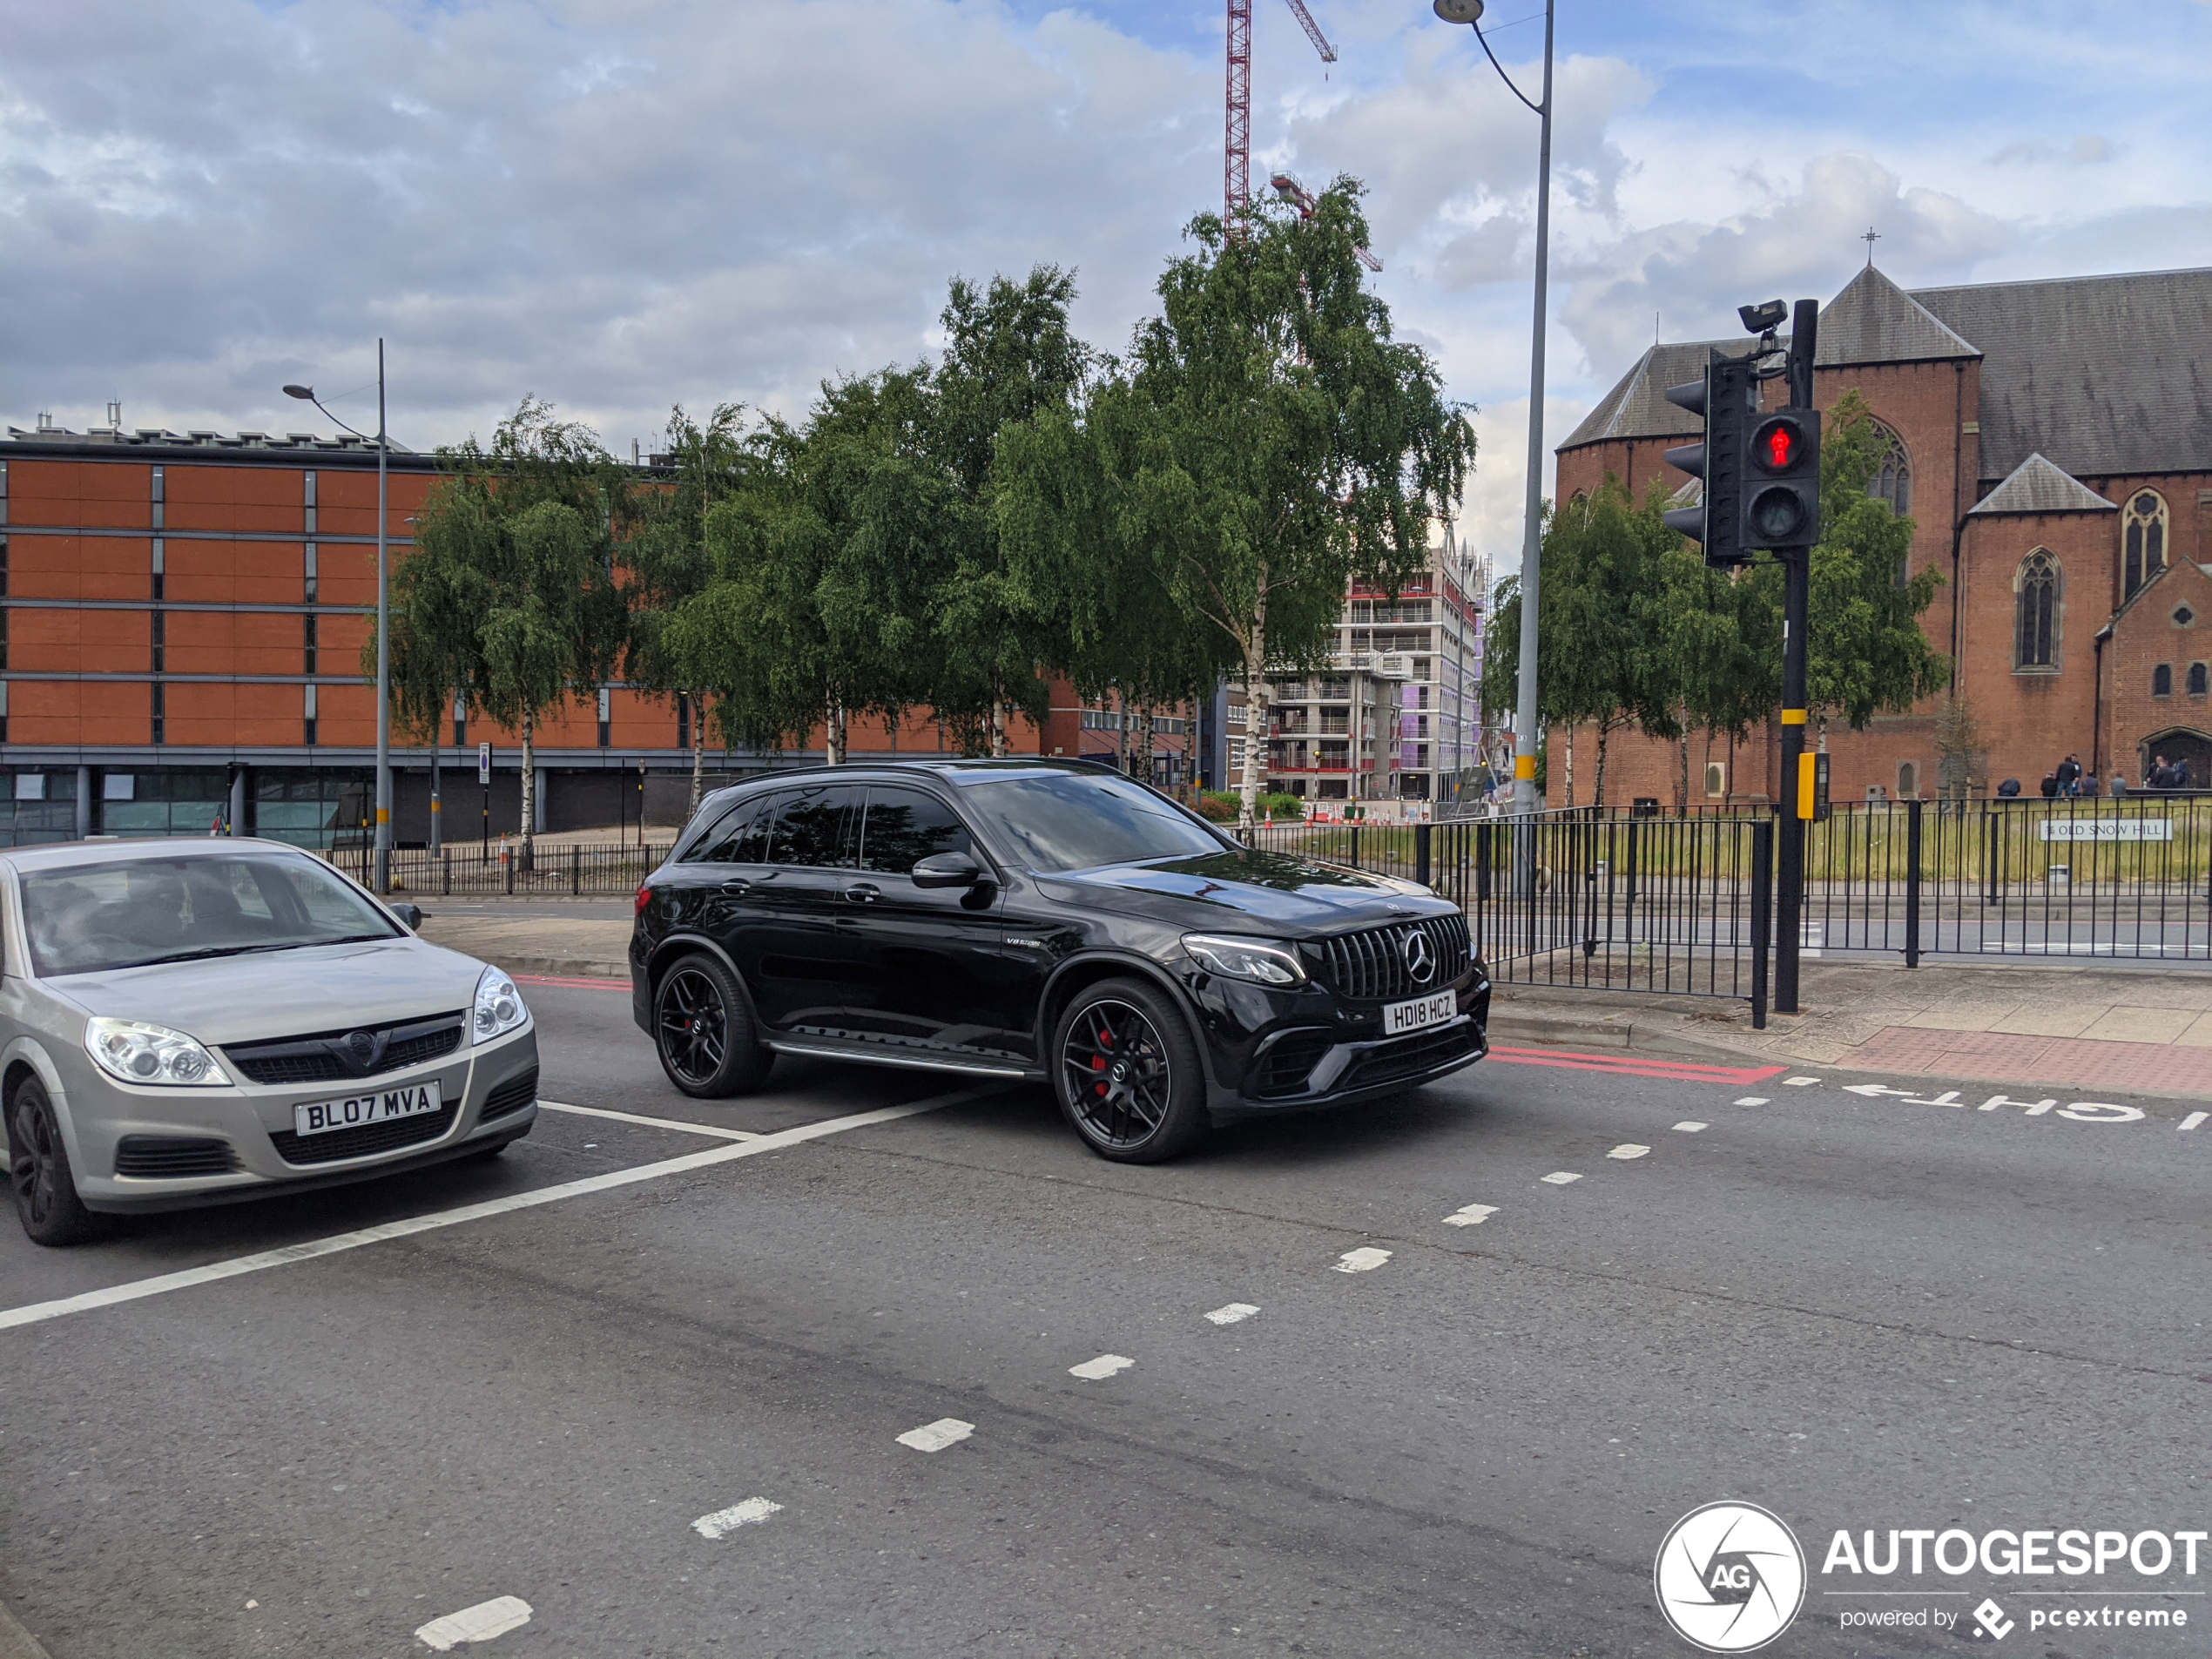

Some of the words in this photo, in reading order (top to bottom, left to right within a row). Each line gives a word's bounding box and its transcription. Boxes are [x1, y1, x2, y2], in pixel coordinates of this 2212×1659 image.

[2059, 826, 2084, 835] OLD
[2089, 825, 2128, 835] SNOW
[2133, 825, 2161, 835] HILL
[1394, 1002, 1426, 1028] HD18
[1429, 995, 1451, 1021] HCZ
[307, 1096, 376, 1130] BL07
[384, 1087, 430, 1116] MVA
